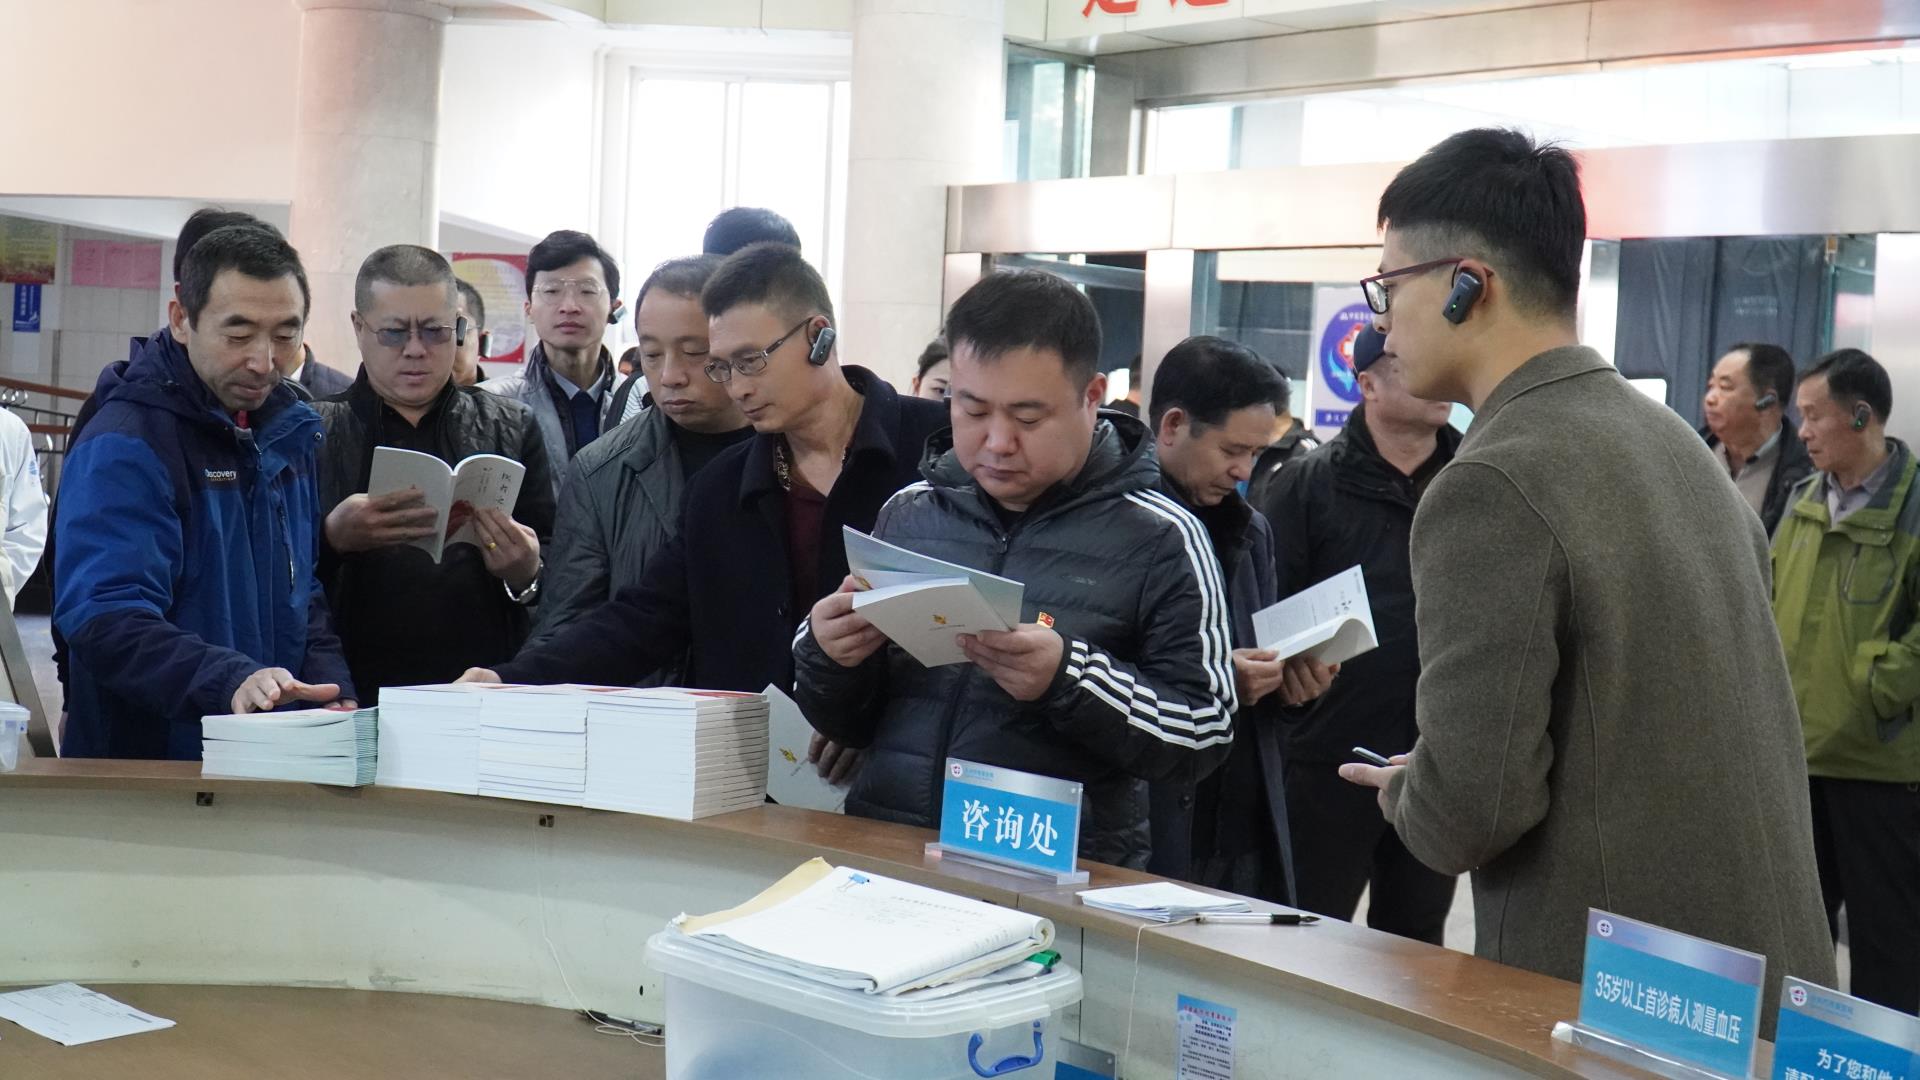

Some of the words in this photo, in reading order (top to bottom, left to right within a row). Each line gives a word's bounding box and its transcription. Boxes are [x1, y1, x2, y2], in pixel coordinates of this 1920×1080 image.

[962, 799, 1058, 857] 咨询处
[1595, 971, 1743, 1044] 35岁以上首诊病人测量血压
